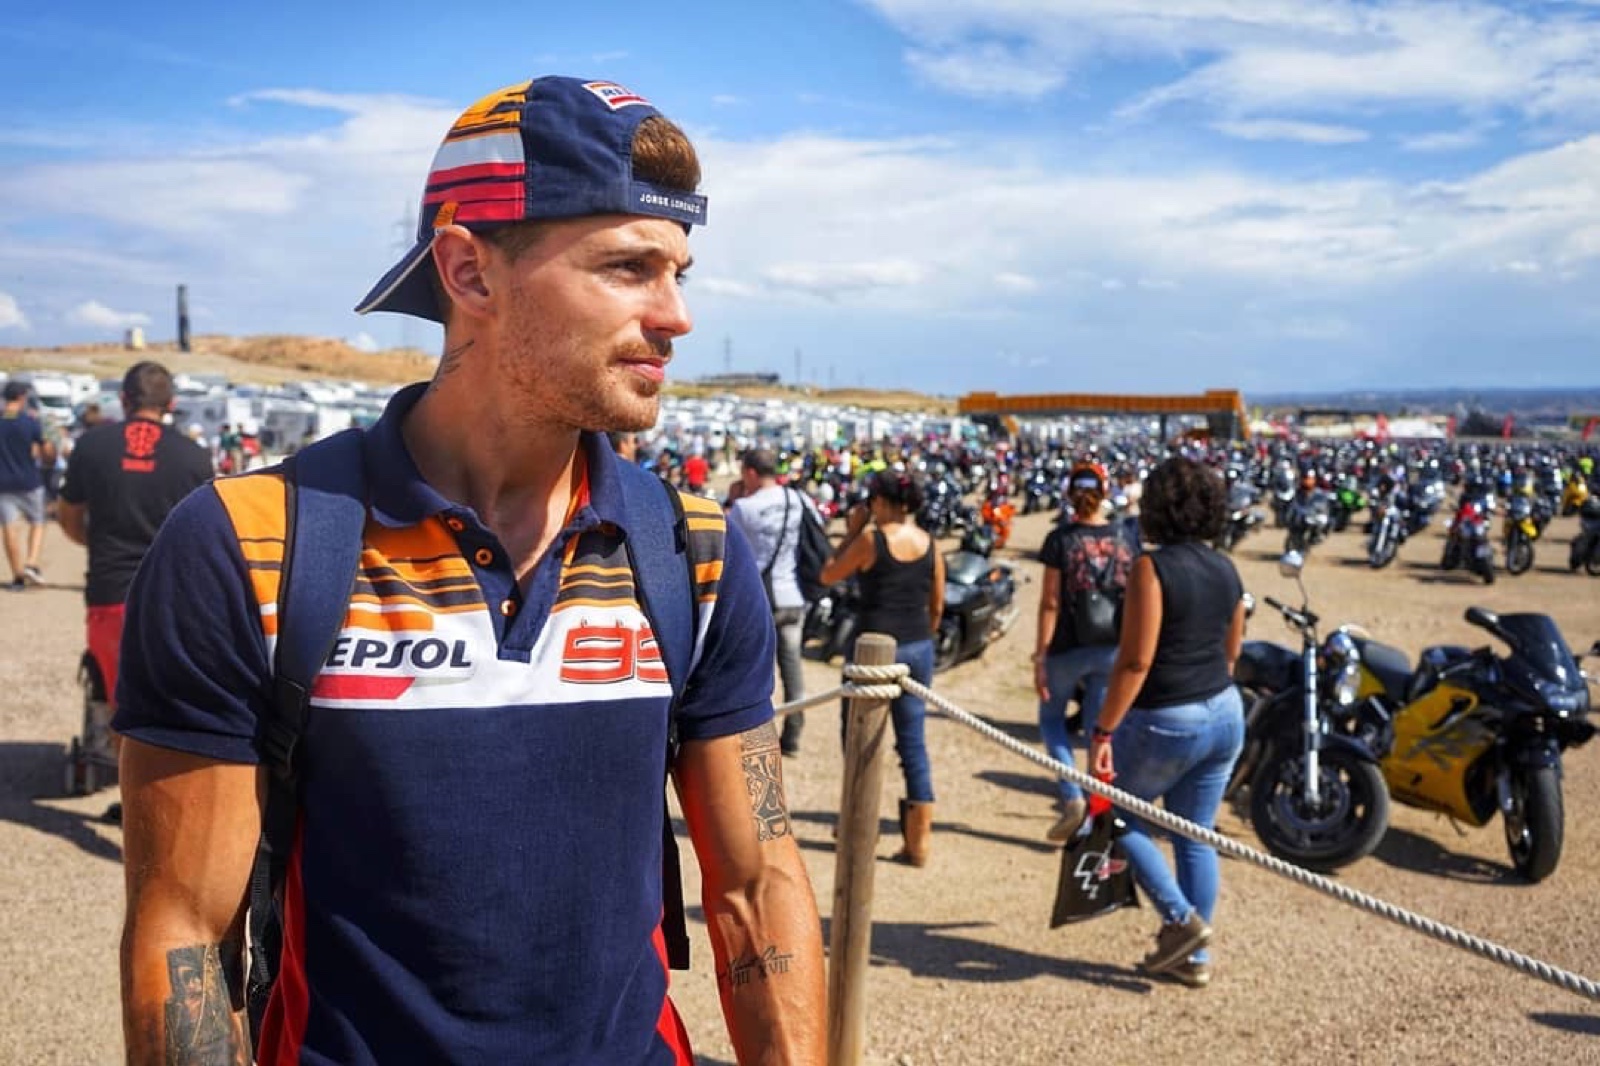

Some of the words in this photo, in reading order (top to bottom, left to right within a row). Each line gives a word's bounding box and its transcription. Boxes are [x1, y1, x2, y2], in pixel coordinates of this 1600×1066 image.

[640, 194, 669, 207] JORGE
[671, 199, 701, 214] LORENZO
[326, 637, 472, 670] EPSOL
